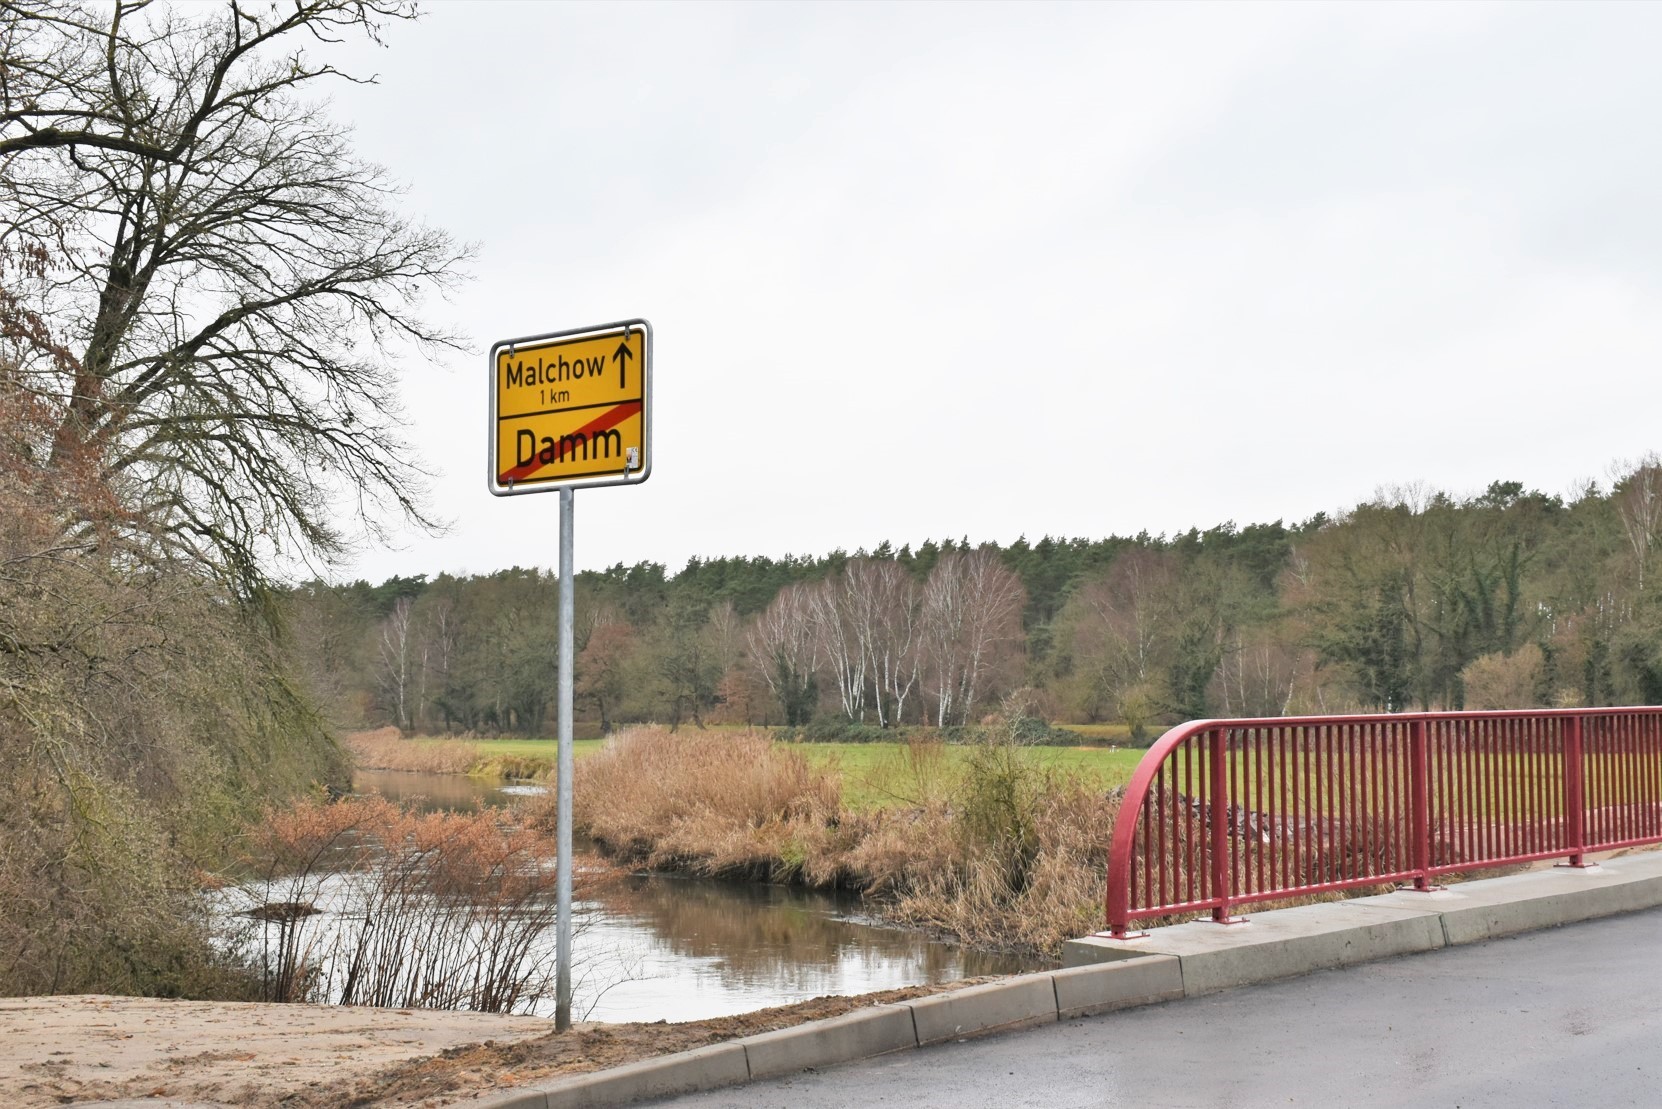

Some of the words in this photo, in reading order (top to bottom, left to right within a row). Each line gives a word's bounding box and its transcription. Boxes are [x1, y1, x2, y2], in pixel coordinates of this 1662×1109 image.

[506, 355, 606, 389] Malchow
[540, 389, 545, 405] 1
[550, 388, 570, 403] km
[517, 428, 621, 468] Damm
